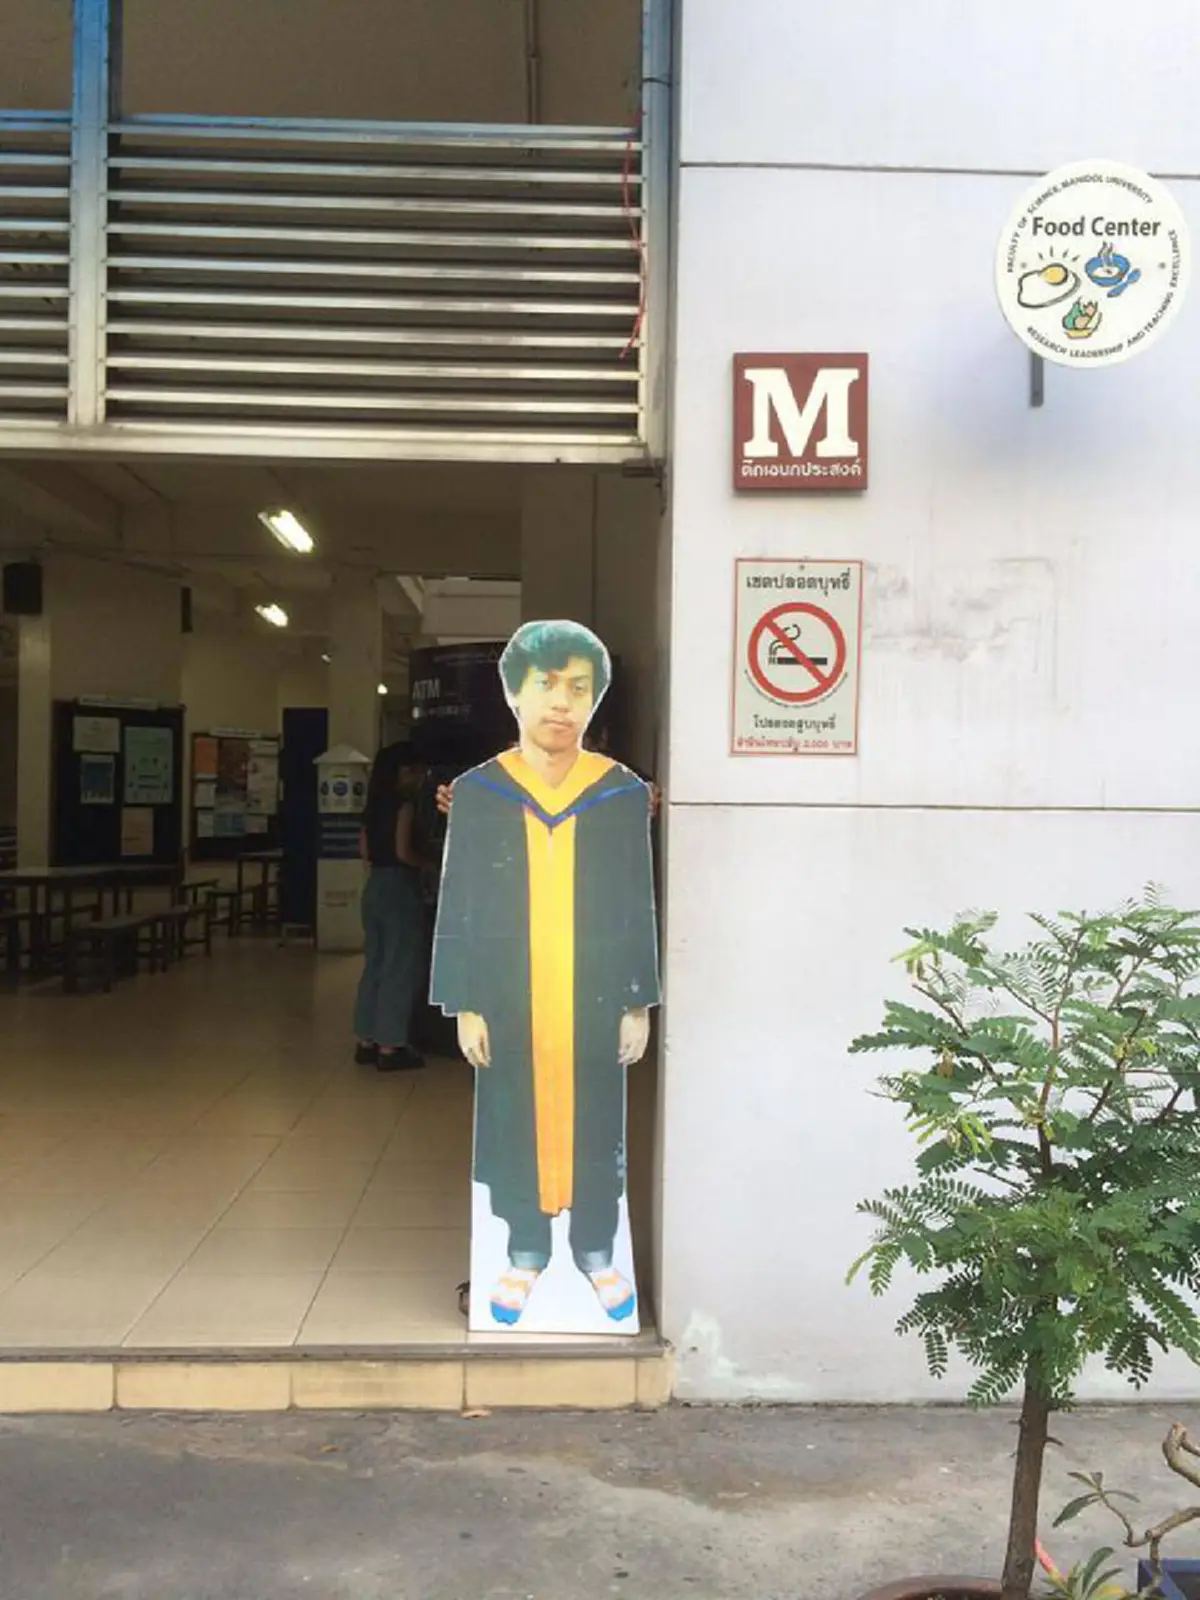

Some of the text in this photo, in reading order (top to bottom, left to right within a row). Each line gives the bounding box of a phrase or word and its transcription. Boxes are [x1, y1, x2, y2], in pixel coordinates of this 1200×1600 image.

[1007, 231, 1021, 273] FACULTY
[1018, 217, 1028, 229] OF
[1061, 174, 1104, 190] MAHIDOL
[1106, 176, 1153, 204] UNIVERSITY
[1032, 216, 1161, 237] Food Center
[1026, 229, 1181, 359] RESEARCH LEADERSHIP AND TEACHING EXCELLENCE
[743, 367, 860, 458] M
[746, 567, 851, 596] เขตปลอดบุหรี่
[412, 677, 441, 701] ATM
